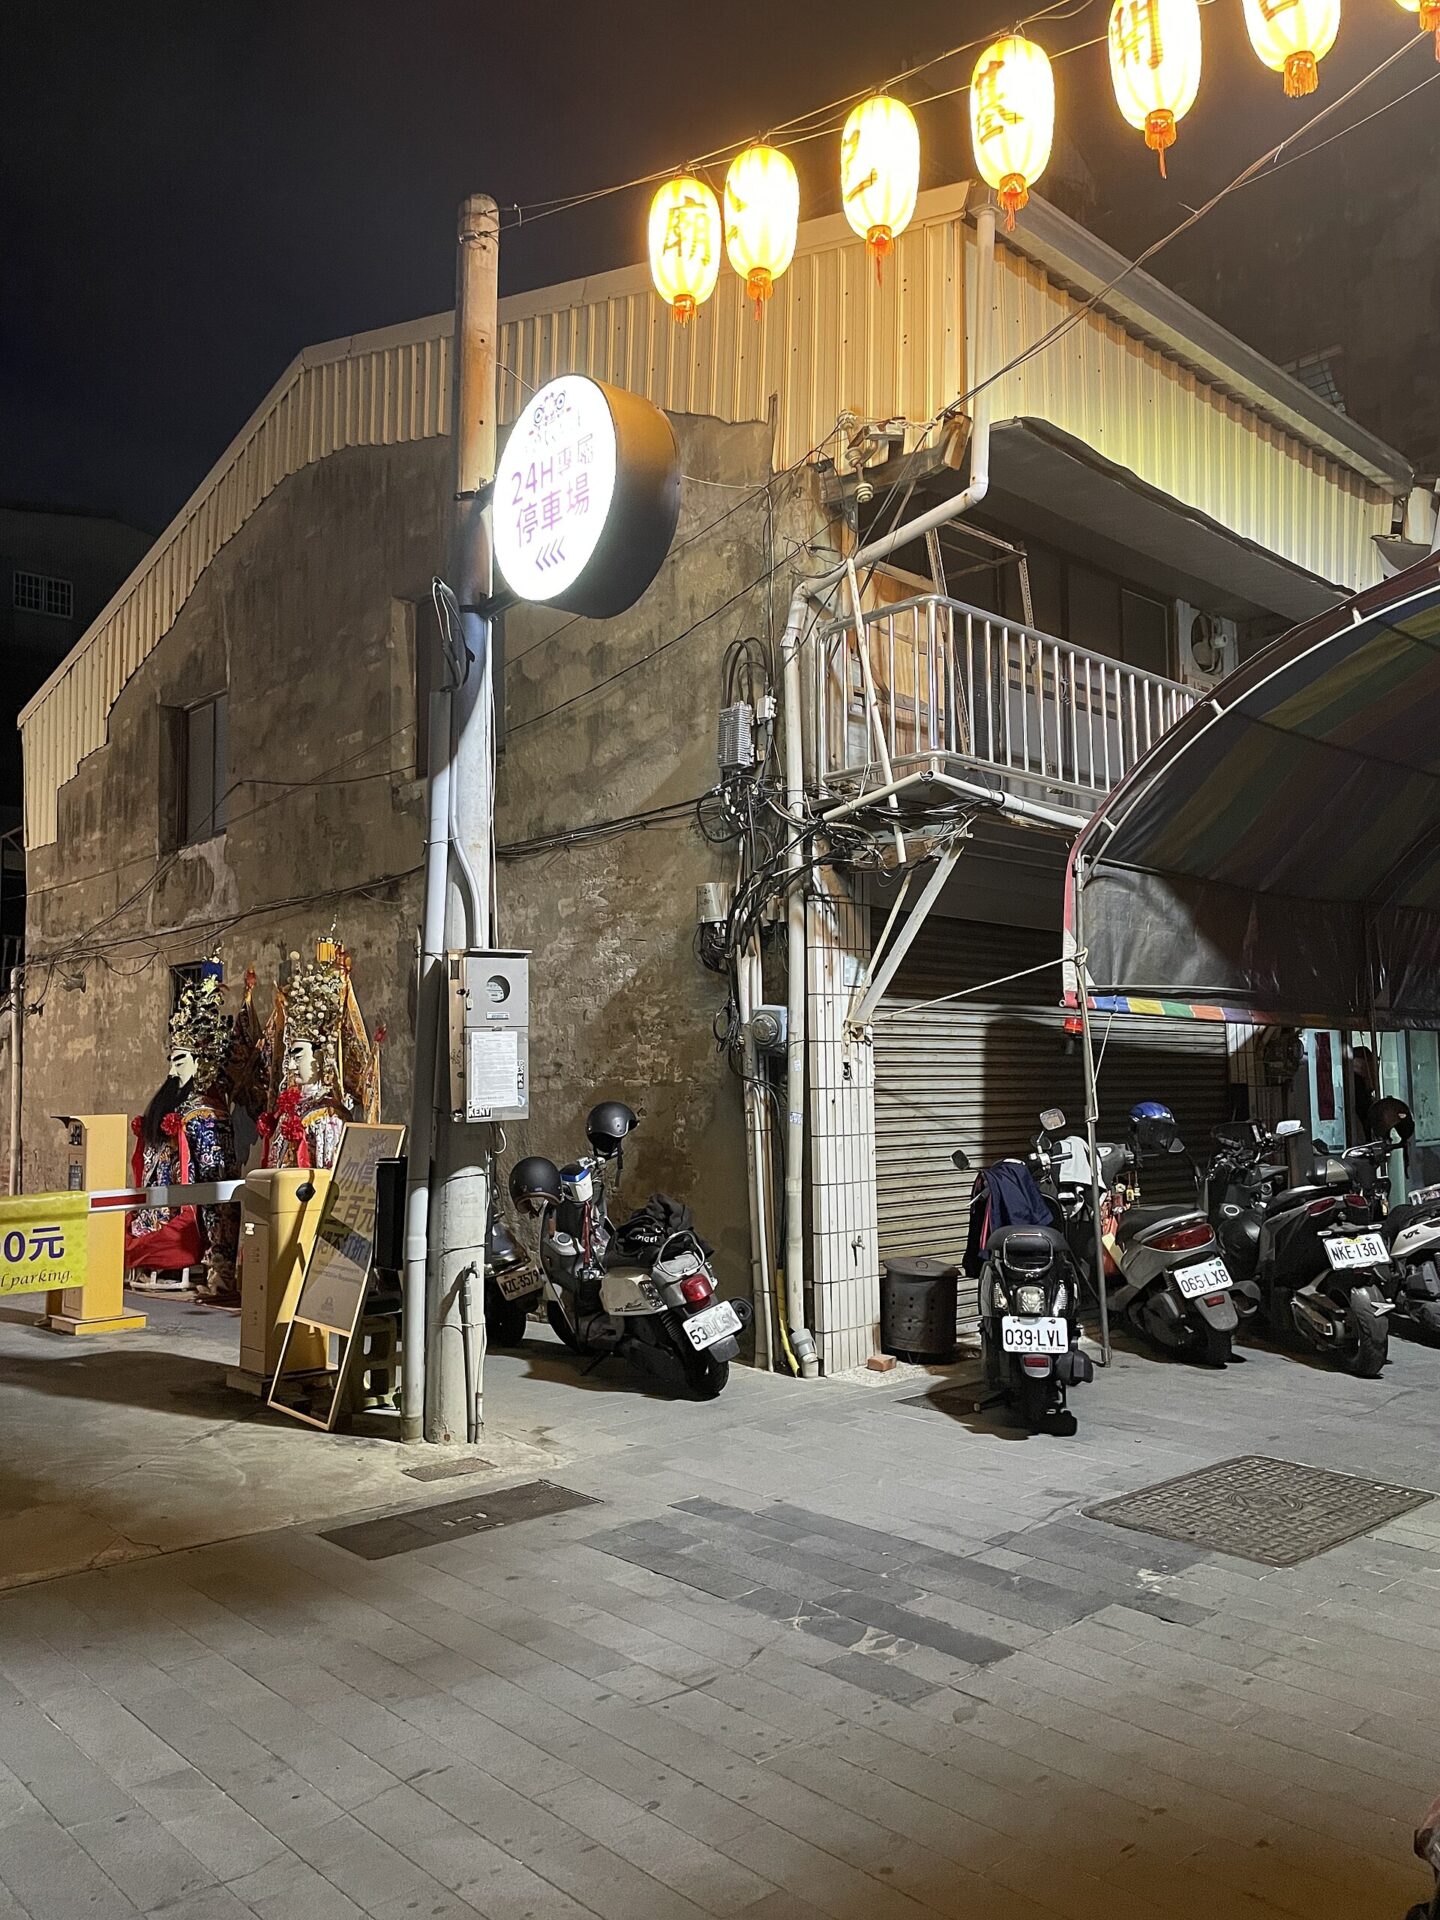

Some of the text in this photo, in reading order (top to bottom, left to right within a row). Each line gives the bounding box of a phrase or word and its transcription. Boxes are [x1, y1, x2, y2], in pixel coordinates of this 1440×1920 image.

[516, 472, 590, 548] 停車場
[0, 1226, 65, 1263] 0元
